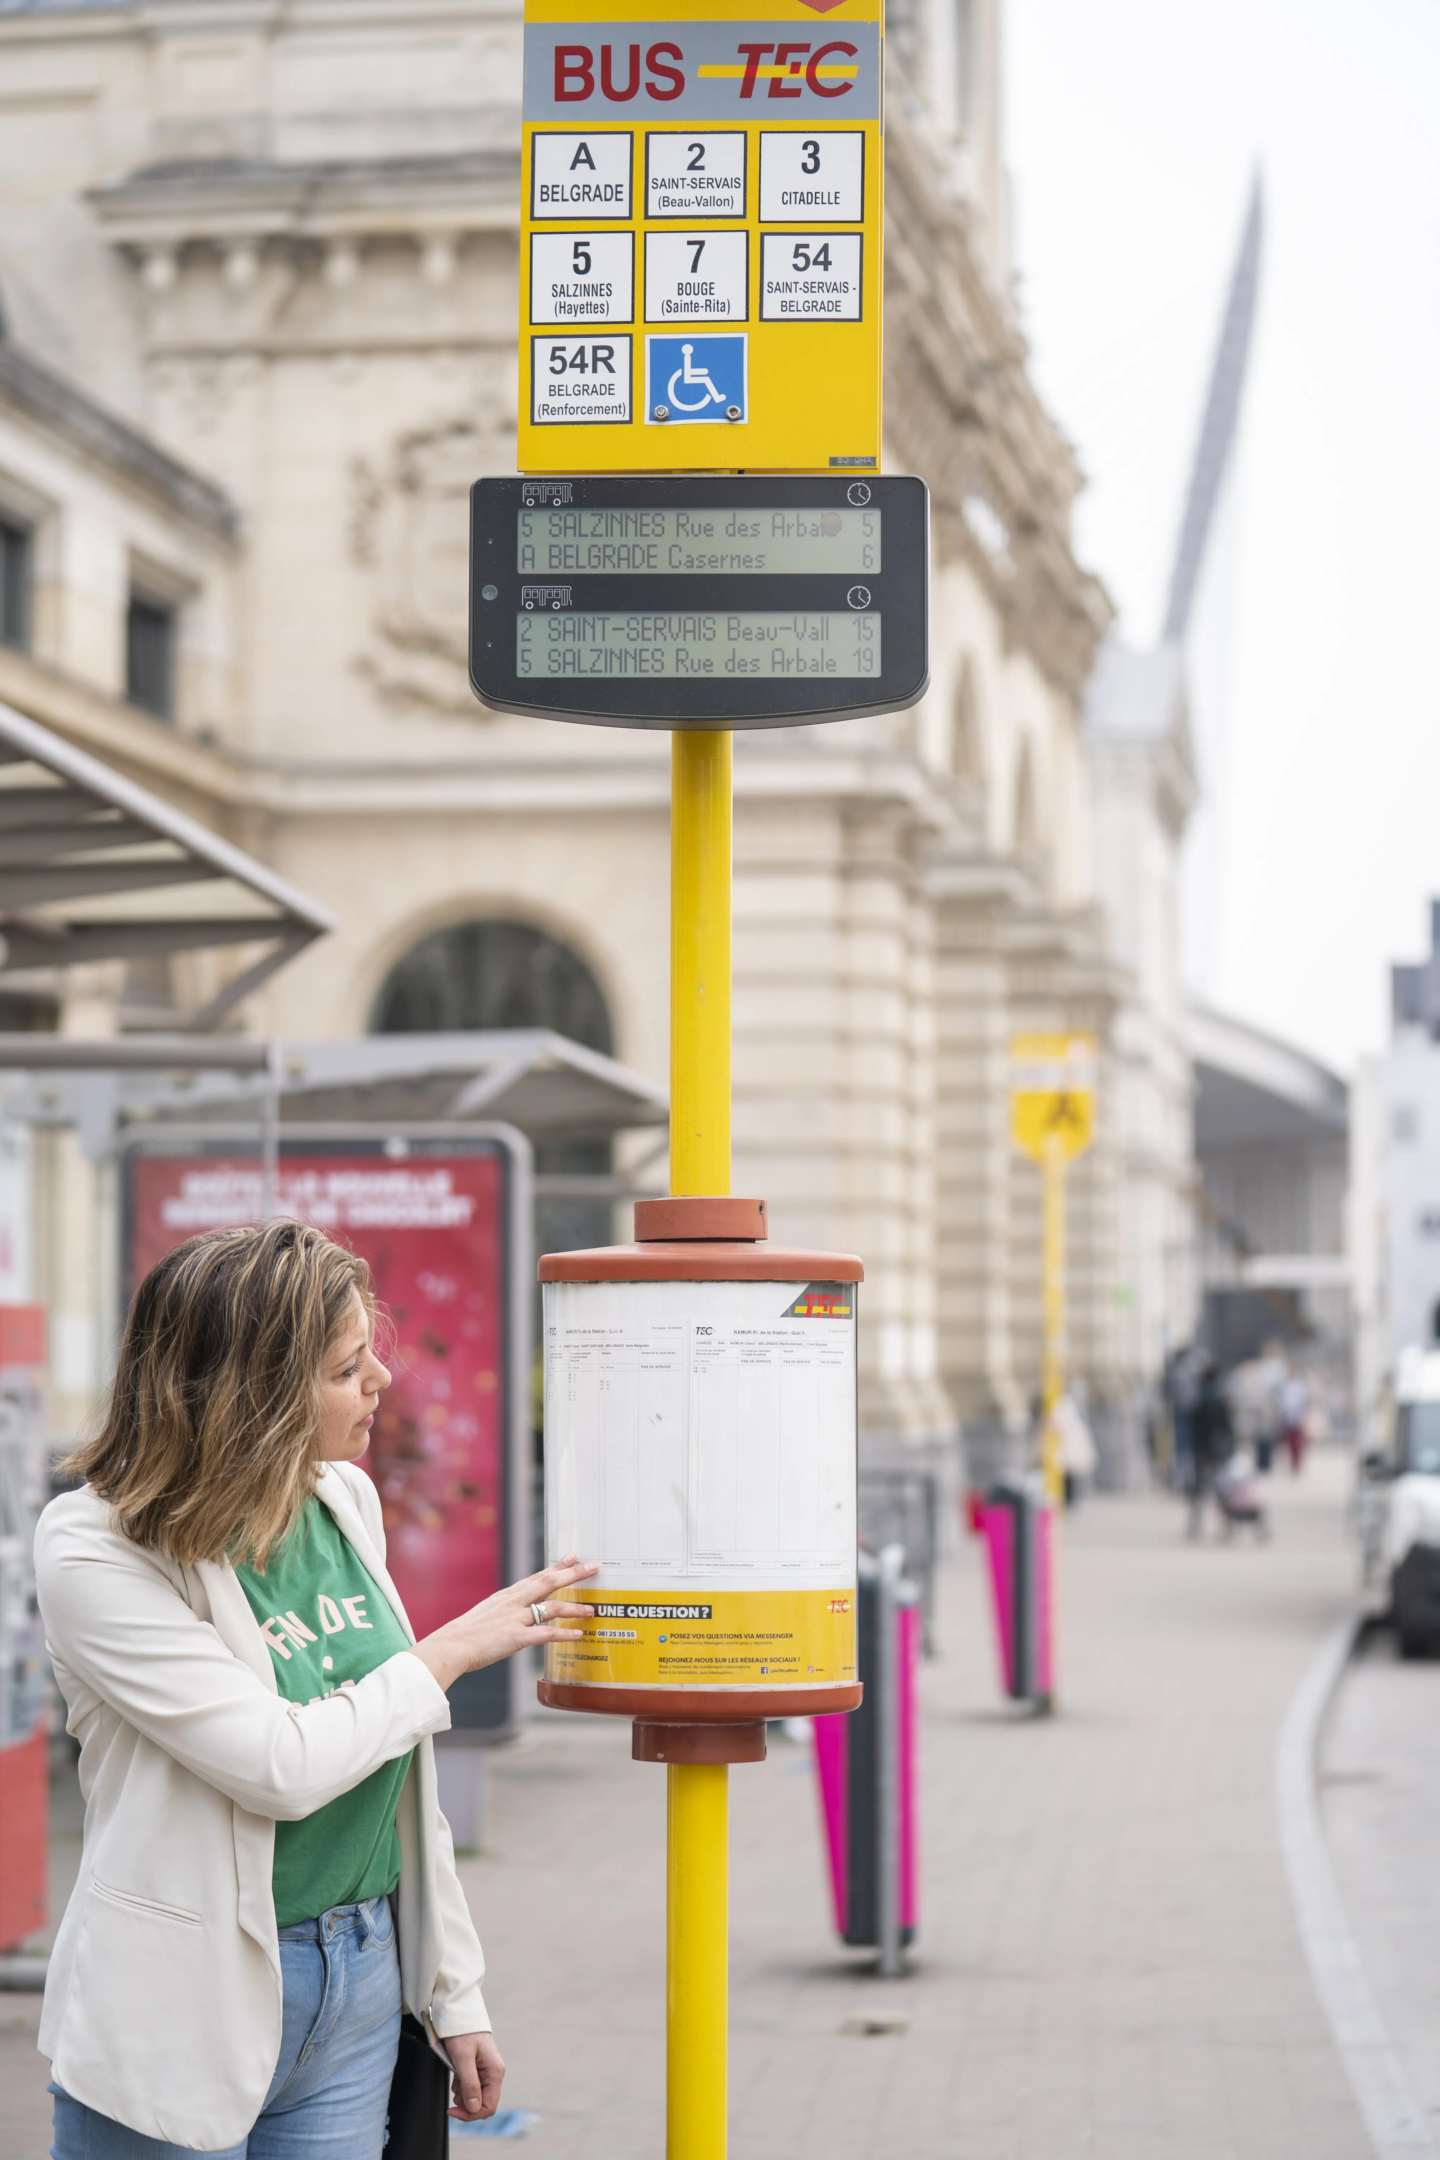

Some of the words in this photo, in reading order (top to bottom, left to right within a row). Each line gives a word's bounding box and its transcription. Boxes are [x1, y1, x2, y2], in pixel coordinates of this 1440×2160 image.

[554, 42, 686, 102] BUS
[737, 41, 859, 99] TEC
[569, 142, 597, 171] A
[686, 143, 706, 171] 2
[800, 140, 821, 174] 3
[540, 184, 624, 203] BELGRADE
[651, 177, 742, 191] SAINT-SERVAIS
[658, 195, 734, 210] (Beau-Vallon)
[781, 191, 840, 206] CITADELLE
[572, 241, 592, 276] 5
[686, 240, 706, 274] 7
[792, 242, 832, 272] 54
[551, 283, 612, 298] SALZINNES
[677, 282, 716, 296] BOUGE
[766, 281, 849, 294] SAINT-SERVAIS
[554, 300, 610, 318] (Hayettes)
[661, 298, 731, 316] (Sainte-Rita)
[780, 300, 842, 313] BELGRADE
[548, 344, 616, 375] 54R
[548, 383, 616, 397] BELGRADE
[538, 402, 626, 418] (Renforcement)
[522, 512, 533, 538] 5
[549, 512, 665, 538] SALZINNES
[676, 512, 714, 538] Rue
[726, 512, 760, 538] des
[862, 512, 874, 538] 5
[522, 544, 535, 569] A
[549, 544, 658, 569] BELGRADE
[668, 544, 766, 569] Casernes
[862, 544, 874, 569] 6
[521, 617, 532, 642] 2
[548, 617, 716, 642] SAINT-SERVAIS
[727, 616, 829, 641] Beau-Vall
[852, 616, 874, 641] 15
[521, 648, 532, 674] 5
[548, 648, 664, 674] SALZINNES
[676, 648, 714, 673] Rue
[725, 648, 760, 673] des
[772, 648, 836, 673] Arbale
[852, 648, 874, 673] 19
[804, 1294, 844, 1319] TEC
[696, 1326, 713, 1336] TEC
[318, 1594, 374, 1634] DE
[598, 1606, 624, 1617] UNE
[627, 1606, 699, 1618] QUESTION
[702, 1607, 709, 1618] ?
[831, 1599, 848, 1613] TEC
